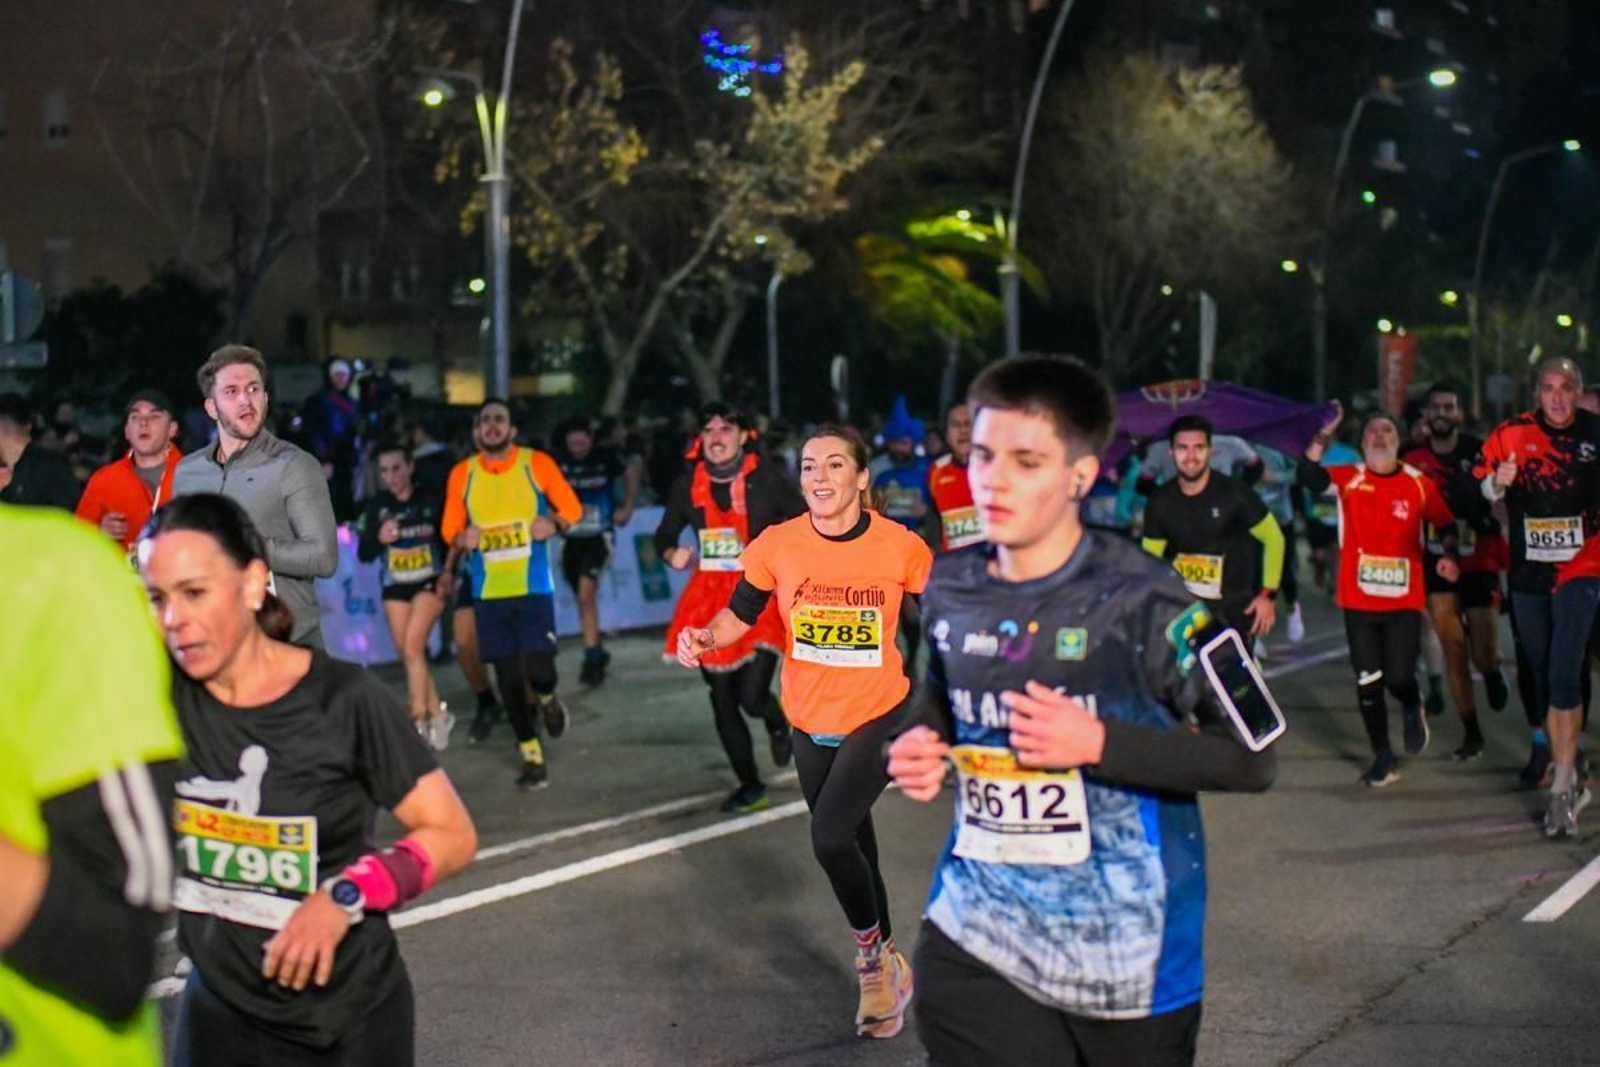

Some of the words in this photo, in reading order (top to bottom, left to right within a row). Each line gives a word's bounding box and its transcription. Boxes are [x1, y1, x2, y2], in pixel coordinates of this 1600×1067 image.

[1529, 529, 1575, 547] 9651
[1362, 566, 1405, 584] 2408
[845, 586, 885, 607] Cortijo
[800, 622, 873, 644] 3785
[966, 778, 1069, 820] 6612
[177, 834, 303, 889] 1796
